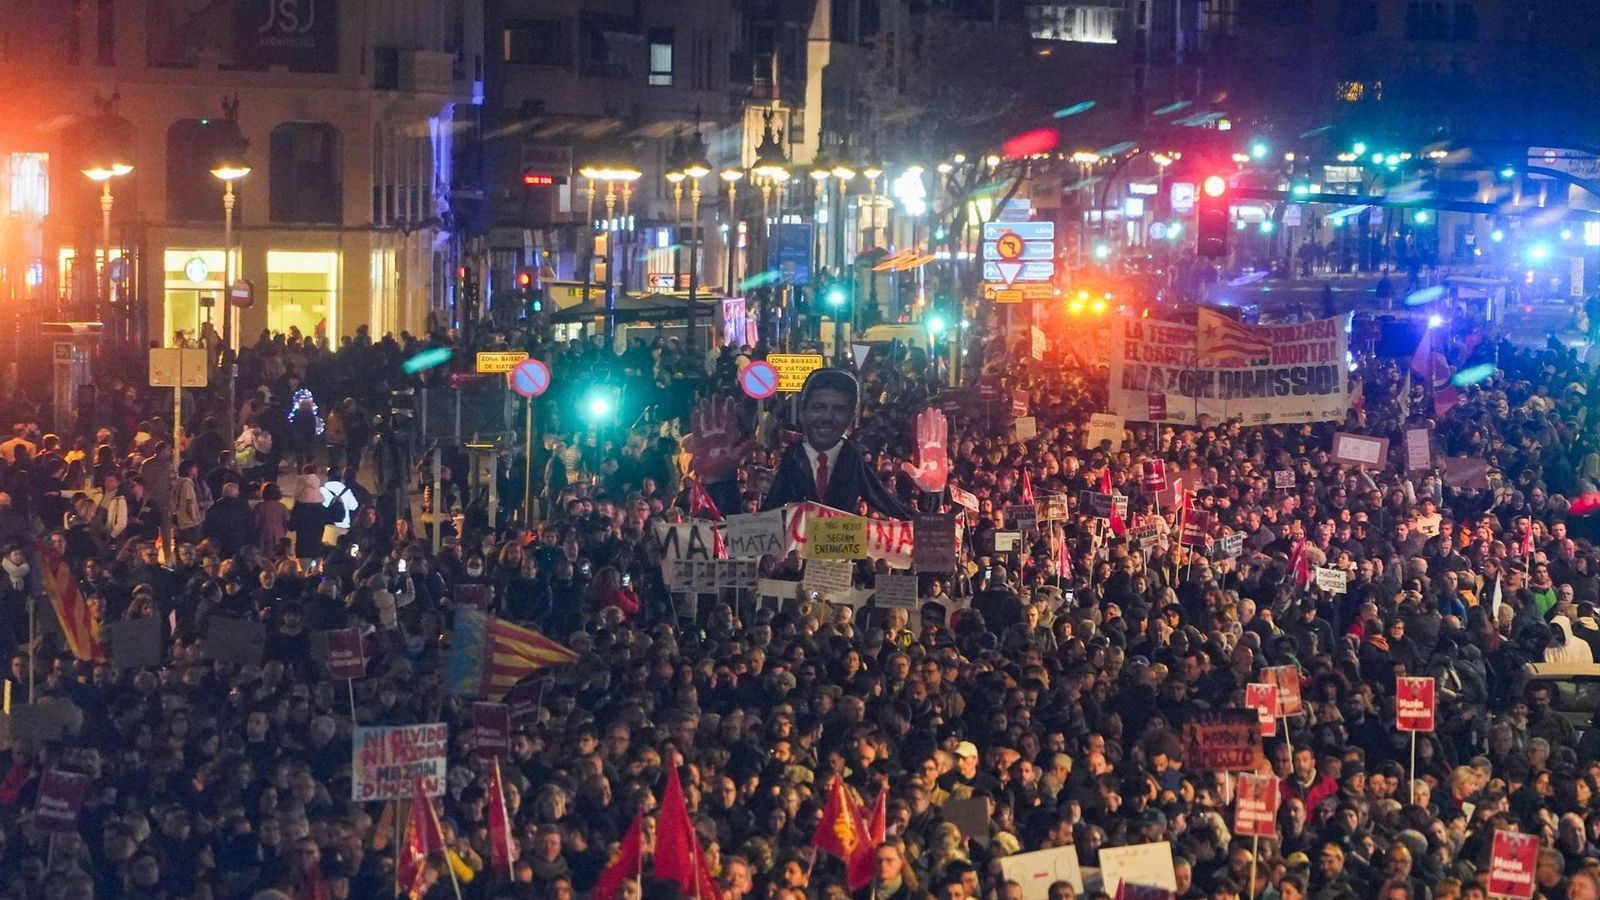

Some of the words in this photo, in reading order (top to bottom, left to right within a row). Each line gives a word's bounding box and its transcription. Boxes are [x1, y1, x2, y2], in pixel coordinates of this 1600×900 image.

[1218, 360, 1341, 400] DIMISSIÓ!
[731, 533, 782, 553] MATA
[1400, 699, 1424, 709] Mazón
[1400, 708, 1431, 718] dimissió
[1495, 856, 1523, 870] Mazón
[1493, 868, 1531, 884] dimissió
